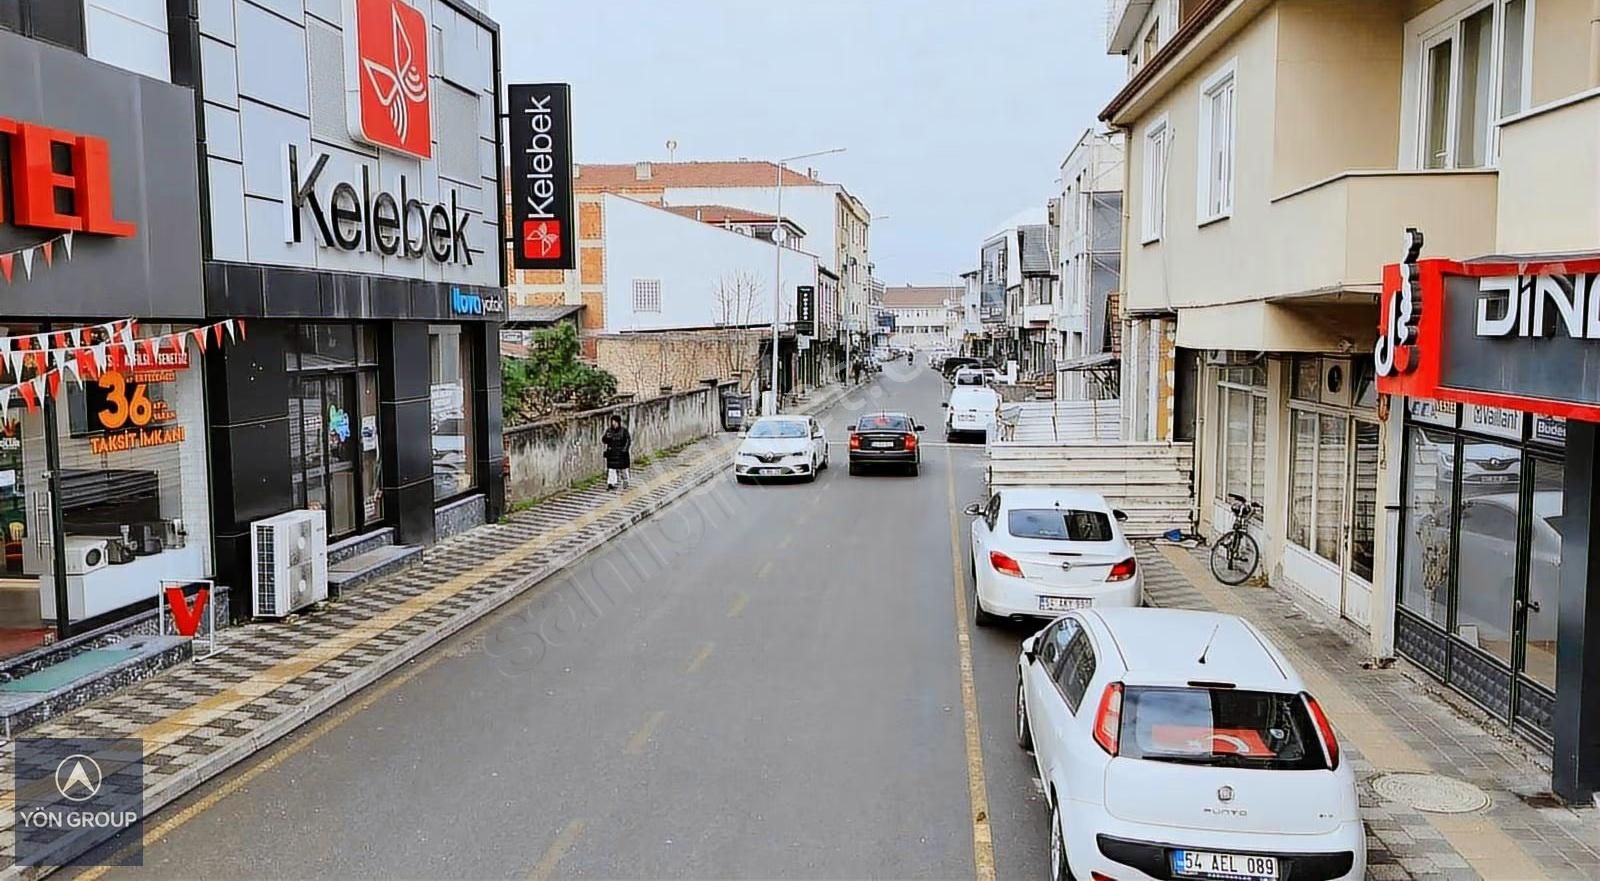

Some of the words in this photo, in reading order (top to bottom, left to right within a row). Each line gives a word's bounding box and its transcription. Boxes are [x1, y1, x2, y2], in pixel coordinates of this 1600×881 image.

[525, 95, 552, 219] Kelebek
[284, 143, 472, 266] Kelebek
[98, 371, 152, 428] 36
[1483, 406, 1519, 430] Vaillant
[90, 429, 137, 454] TAKSİT
[1184, 852, 1202, 869] 54
[1211, 854, 1238, 873] AEL
[1247, 857, 1274, 875] 089
